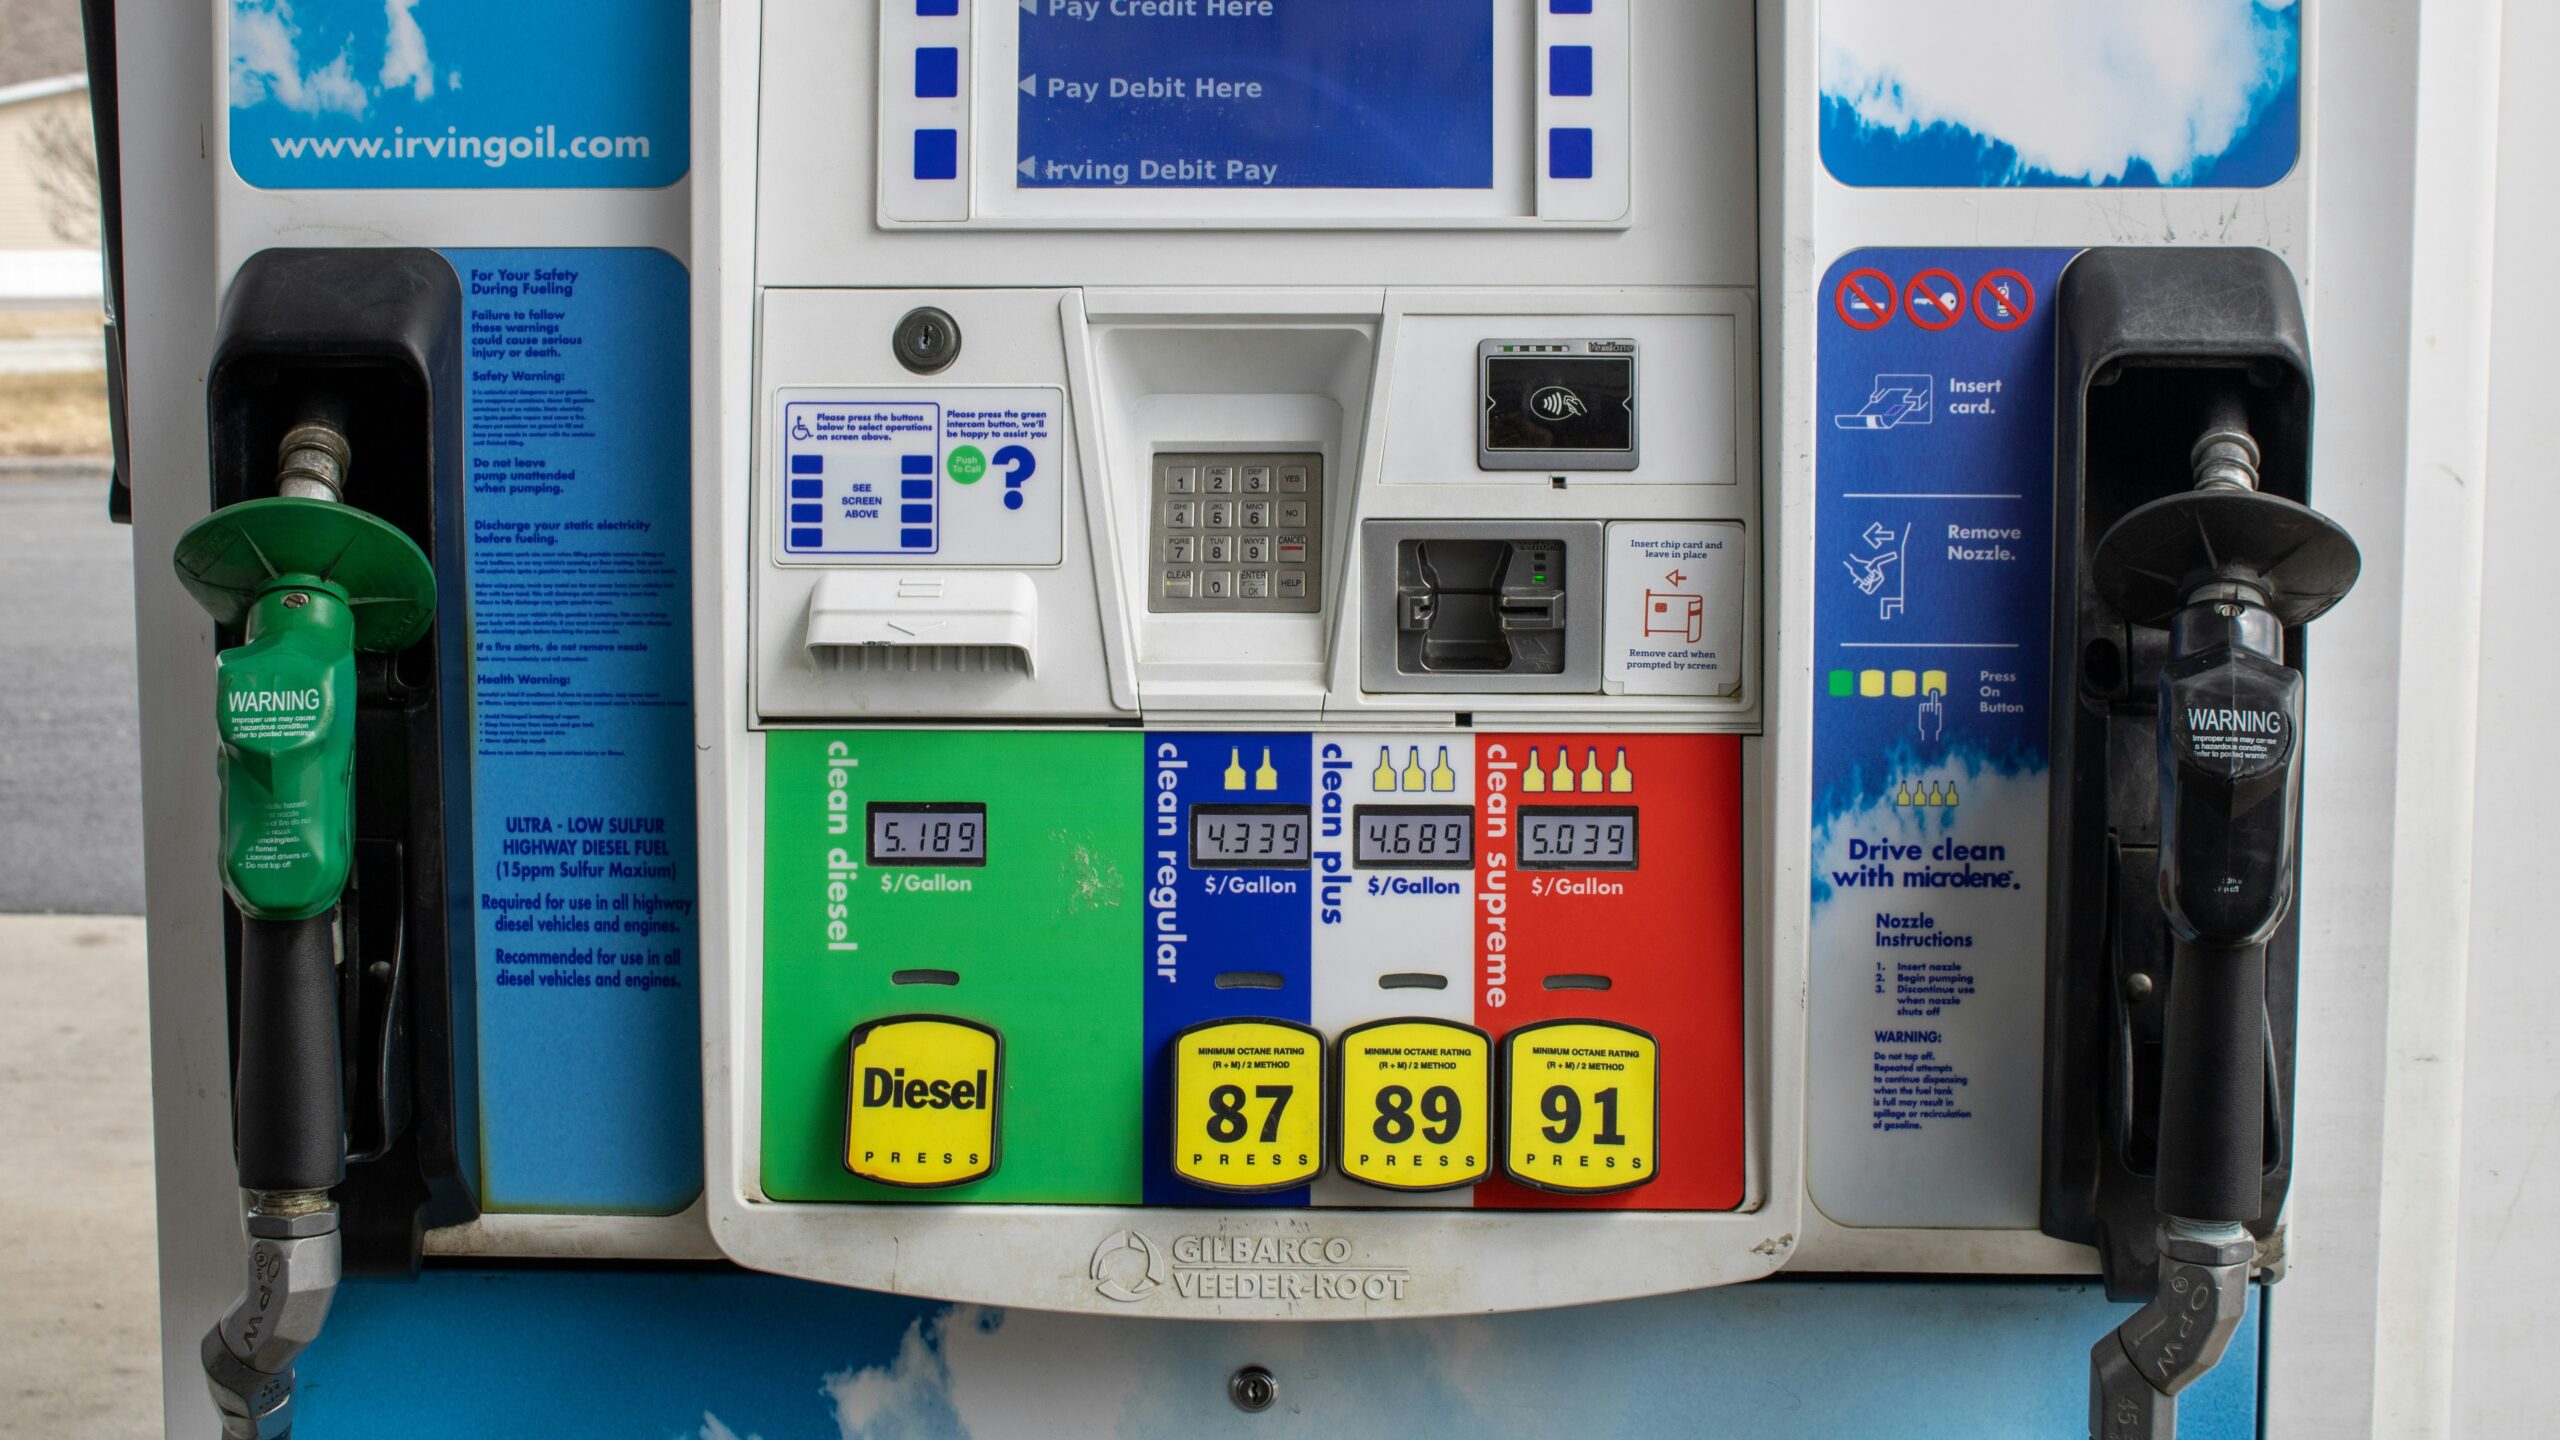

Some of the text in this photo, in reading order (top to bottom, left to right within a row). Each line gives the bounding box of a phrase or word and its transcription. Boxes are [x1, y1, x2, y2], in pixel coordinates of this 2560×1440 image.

[1049, 0, 1273, 22] Pay Credit Here
[1048, 77, 1262, 103] Pay Debit Here
[270, 124, 651, 168] www.irvingoil.com
[1047, 159, 1278, 185] Irving Debit Pay
[471, 268, 578, 284] For Your Safety
[471, 283, 573, 297] During Fueling
[472, 371, 565, 383] Safety Warning:
[1950, 378, 2002, 393] Insert
[947, 410, 975, 418] Please
[1004, 410, 1019, 418] the
[1949, 399, 1996, 414] card.
[817, 413, 924, 423] Please press the buttons
[947, 420, 985, 428] intercom
[988, 420, 1019, 429] button,
[817, 423, 844, 431] below
[858, 423, 883, 431] select
[947, 430, 957, 438] be
[960, 430, 989, 439] happy
[1003, 430, 1027, 438] assist
[1031, 431, 1047, 439] you
[862, 433, 891, 441] above.
[853, 484, 871, 492] SEE
[1178, 477, 1184, 489] 1
[1214, 477, 1222, 489] 2
[1250, 477, 1259, 489] 3
[842, 497, 882, 505] SCREEN
[845, 510, 879, 518] ABOVE
[1176, 512, 1184, 523] 4
[1213, 512, 1222, 524] 5
[1251, 512, 1259, 524] 6
[1948, 525, 2021, 539] Remove
[1631, 540, 1722, 549] Insert chip card and
[1176, 547, 1183, 558] 7
[1212, 547, 1221, 558] 8
[1250, 547, 1258, 559] 9
[1683, 551, 1707, 560] place
[1948, 546, 2016, 561] Nozzle.
[1212, 581, 1220, 593] 0
[1629, 649, 1715, 659] Remove card when
[1627, 661, 1671, 670] prompted
[1674, 661, 1685, 670] by
[477, 675, 571, 687] Health Warning:
[1980, 671, 2016, 682] Press
[1980, 686, 2000, 697] On
[229, 689, 320, 712] WARNING
[1980, 702, 2024, 712] Button
[2188, 708, 2281, 733] WARNING
[506, 818, 552, 833] ULTRA
[568, 818, 604, 833] LOW
[609, 818, 665, 833] SULFUR
[885, 822, 975, 852] 5.189
[1208, 824, 1300, 854] 4.339
[1313, 743, 1352, 924] clean plus
[1370, 824, 1461, 853] 4.689
[1532, 824, 1625, 855] 5.039
[503, 840, 669, 856] HIGHWAY DIESEL FUEL
[828, 741, 858, 951] clean diesel
[1849, 838, 2005, 861] Drive clean
[1149, 742, 1188, 982] clean regular
[497, 861, 676, 881] (15ppm Sulfur Maxium)
[1478, 744, 1518, 1008] clean supreme
[1832, 864, 1894, 887] with
[880, 873, 972, 893] $/Gallon
[1205, 875, 1297, 895] $/Gallon
[1368, 875, 1460, 896] $/Gallon
[1531, 877, 1624, 896] $/Gallon
[482, 893, 692, 916] Required for use in all highway
[495, 916, 680, 937] diesel vehicles and engines.
[1876, 912, 1934, 929] Nozzle
[1876, 931, 1973, 947] Instructions
[1876, 963, 1961, 971] 1. Insert nozzle
[1876, 974, 1974, 984] 2. Begin pumping
[1897, 985, 1954, 994] Discontinue
[1875, 1031, 1942, 1043] WARNING:
[1198, 1047, 1304, 1055] MINIMUM OCTANE RATING
[863, 1067, 987, 1110] Diesel
[1206, 1084, 1294, 1144] 87
[1373, 1085, 1462, 1144] 89
[1540, 1084, 1625, 1145] 91
[1172, 1236, 1352, 1264] GILBARCO
[1173, 1273, 1410, 1299] VEEDER-ROOT
